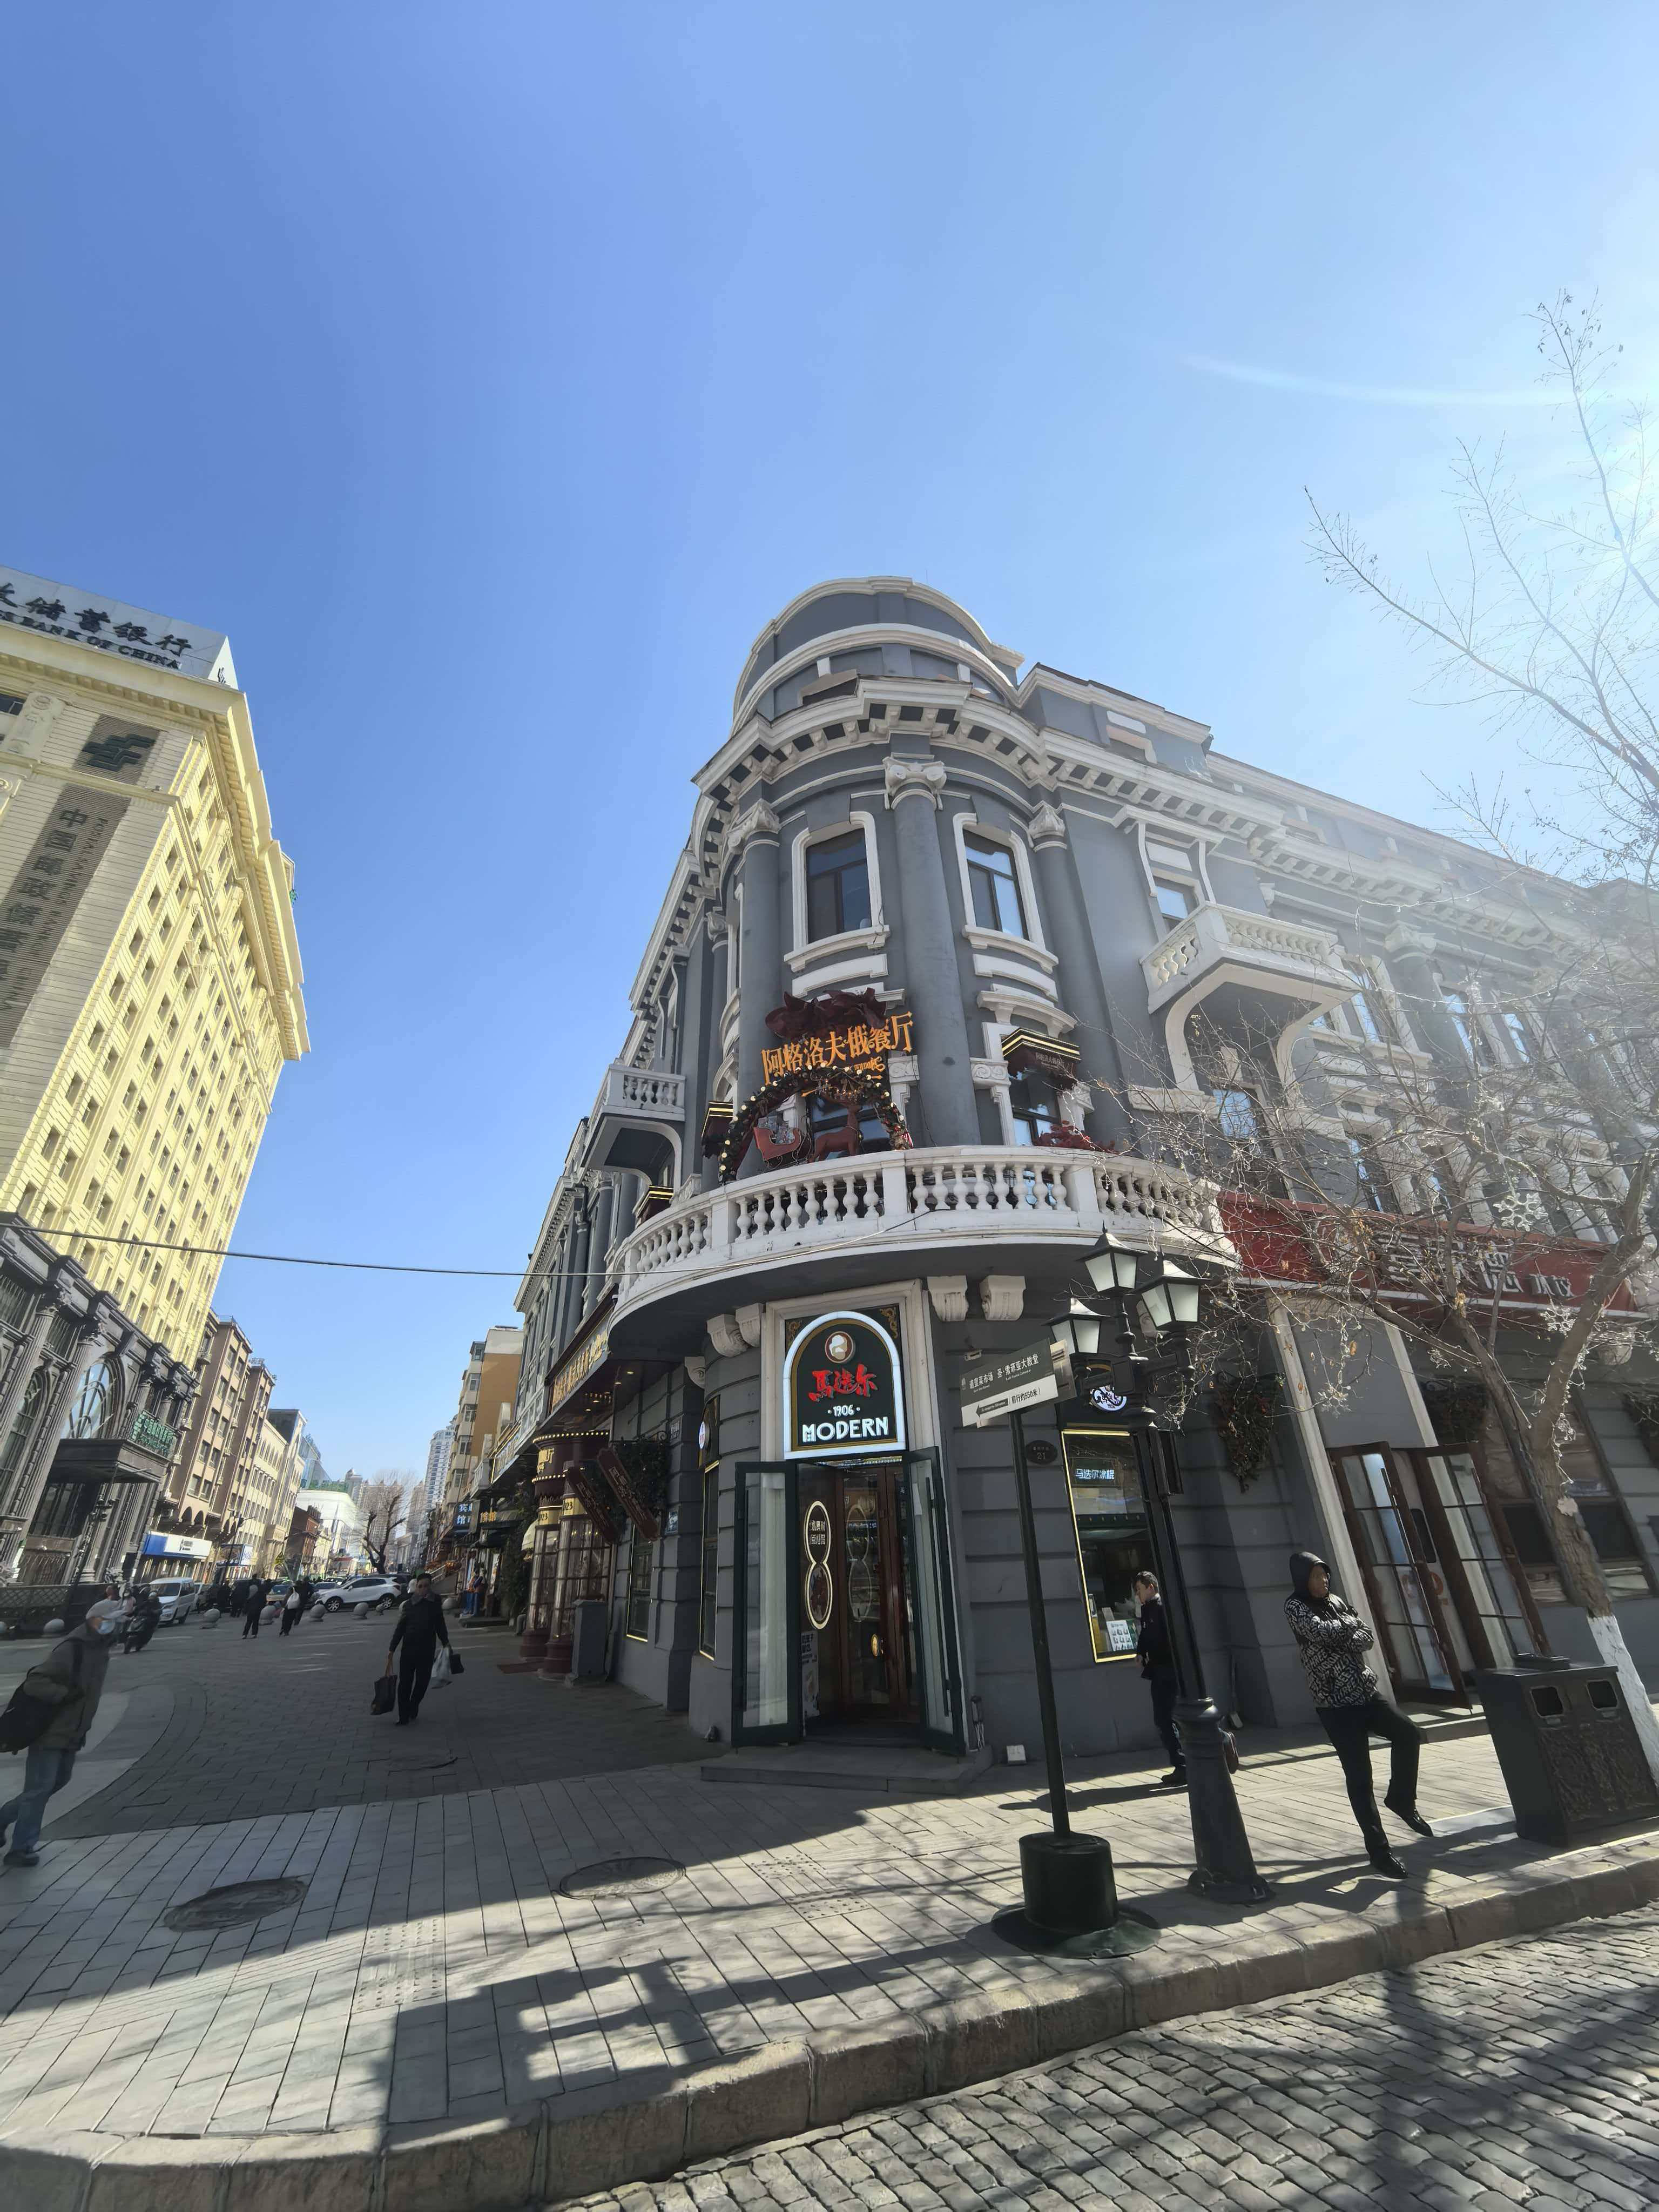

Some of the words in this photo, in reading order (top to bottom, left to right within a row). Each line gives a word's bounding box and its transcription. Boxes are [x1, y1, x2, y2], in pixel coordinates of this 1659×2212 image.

[19, 616, 82, 641] BANK
[86, 636, 113, 649] OF
[118, 646, 182, 670] CHINA
[761, 1011, 914, 1086] 阿格洛夫俄餐厅
[969, 1372, 994, 1389] 道里菜市场
[997, 1354, 1039, 1378] 圣·索菲亚大教堂
[802, 1417, 889, 1443] MODERN
